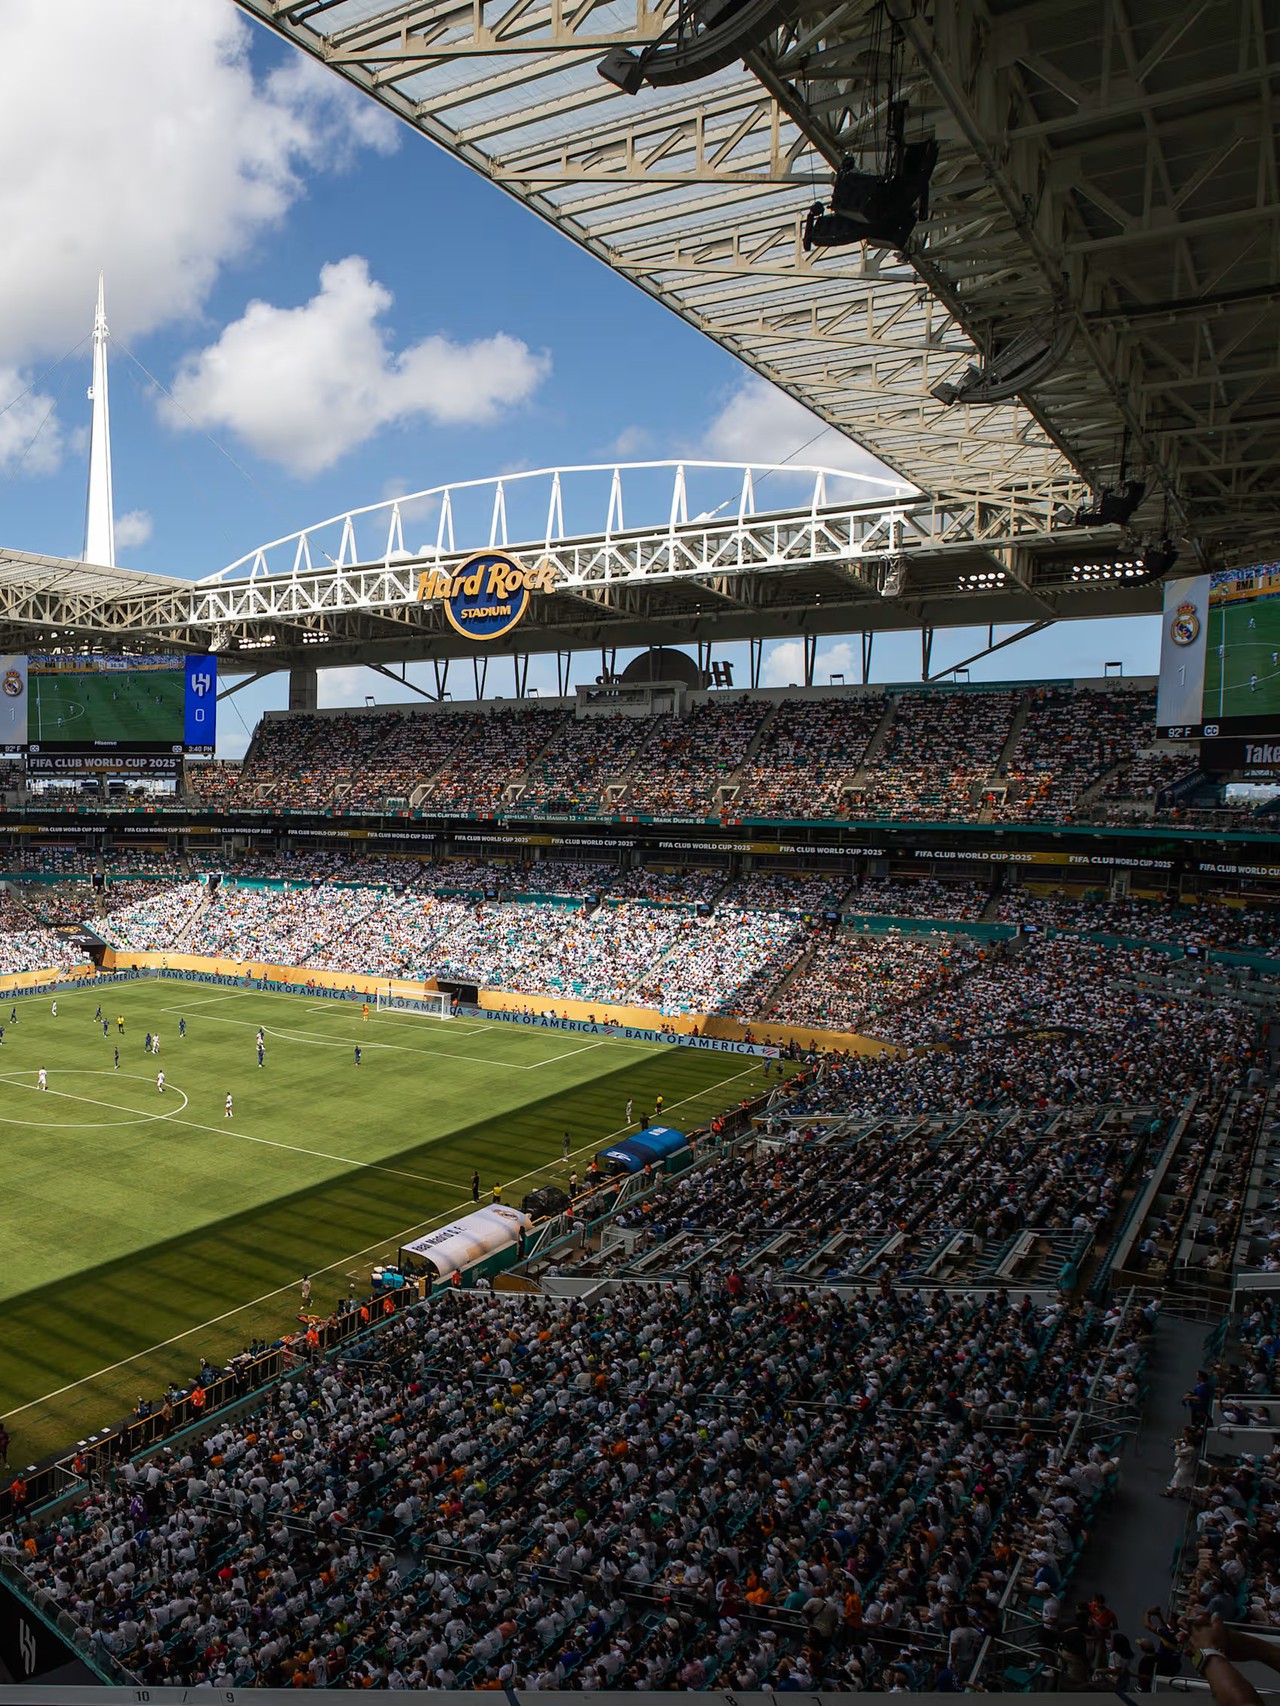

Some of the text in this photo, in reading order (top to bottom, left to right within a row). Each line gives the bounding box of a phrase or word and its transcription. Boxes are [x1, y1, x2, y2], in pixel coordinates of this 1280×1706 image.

[416, 558, 557, 600] Hard Rock
[460, 605, 511, 619] STADIUM
[1178, 664, 1186, 686] 1
[9, 708, 16, 721] 1
[195, 709, 205, 722] 0
[1184, 727, 1192, 737] F
[30, 758, 53, 767] FIFA
[55, 758, 83, 767] CLUB
[85, 758, 123, 767] WORLD
[125, 758, 147, 767] CUP
[1115, 858, 1139, 866] WORLD
[76, 972, 140, 987] BANK OF AMERICA
[161, 970, 238, 986] BANK OF AMERICA
[0, 991, 9, 999] OF
[11, 985, 47, 997] AMERICA
[256, 982, 346, 999] BANK OF AMERICA
[486, 1011, 599, 1034] BANK OF AMERICA
[625, 1029, 755, 1054] BANK OF AMERICA
[136, 1691, 235, 1703] 10 9
